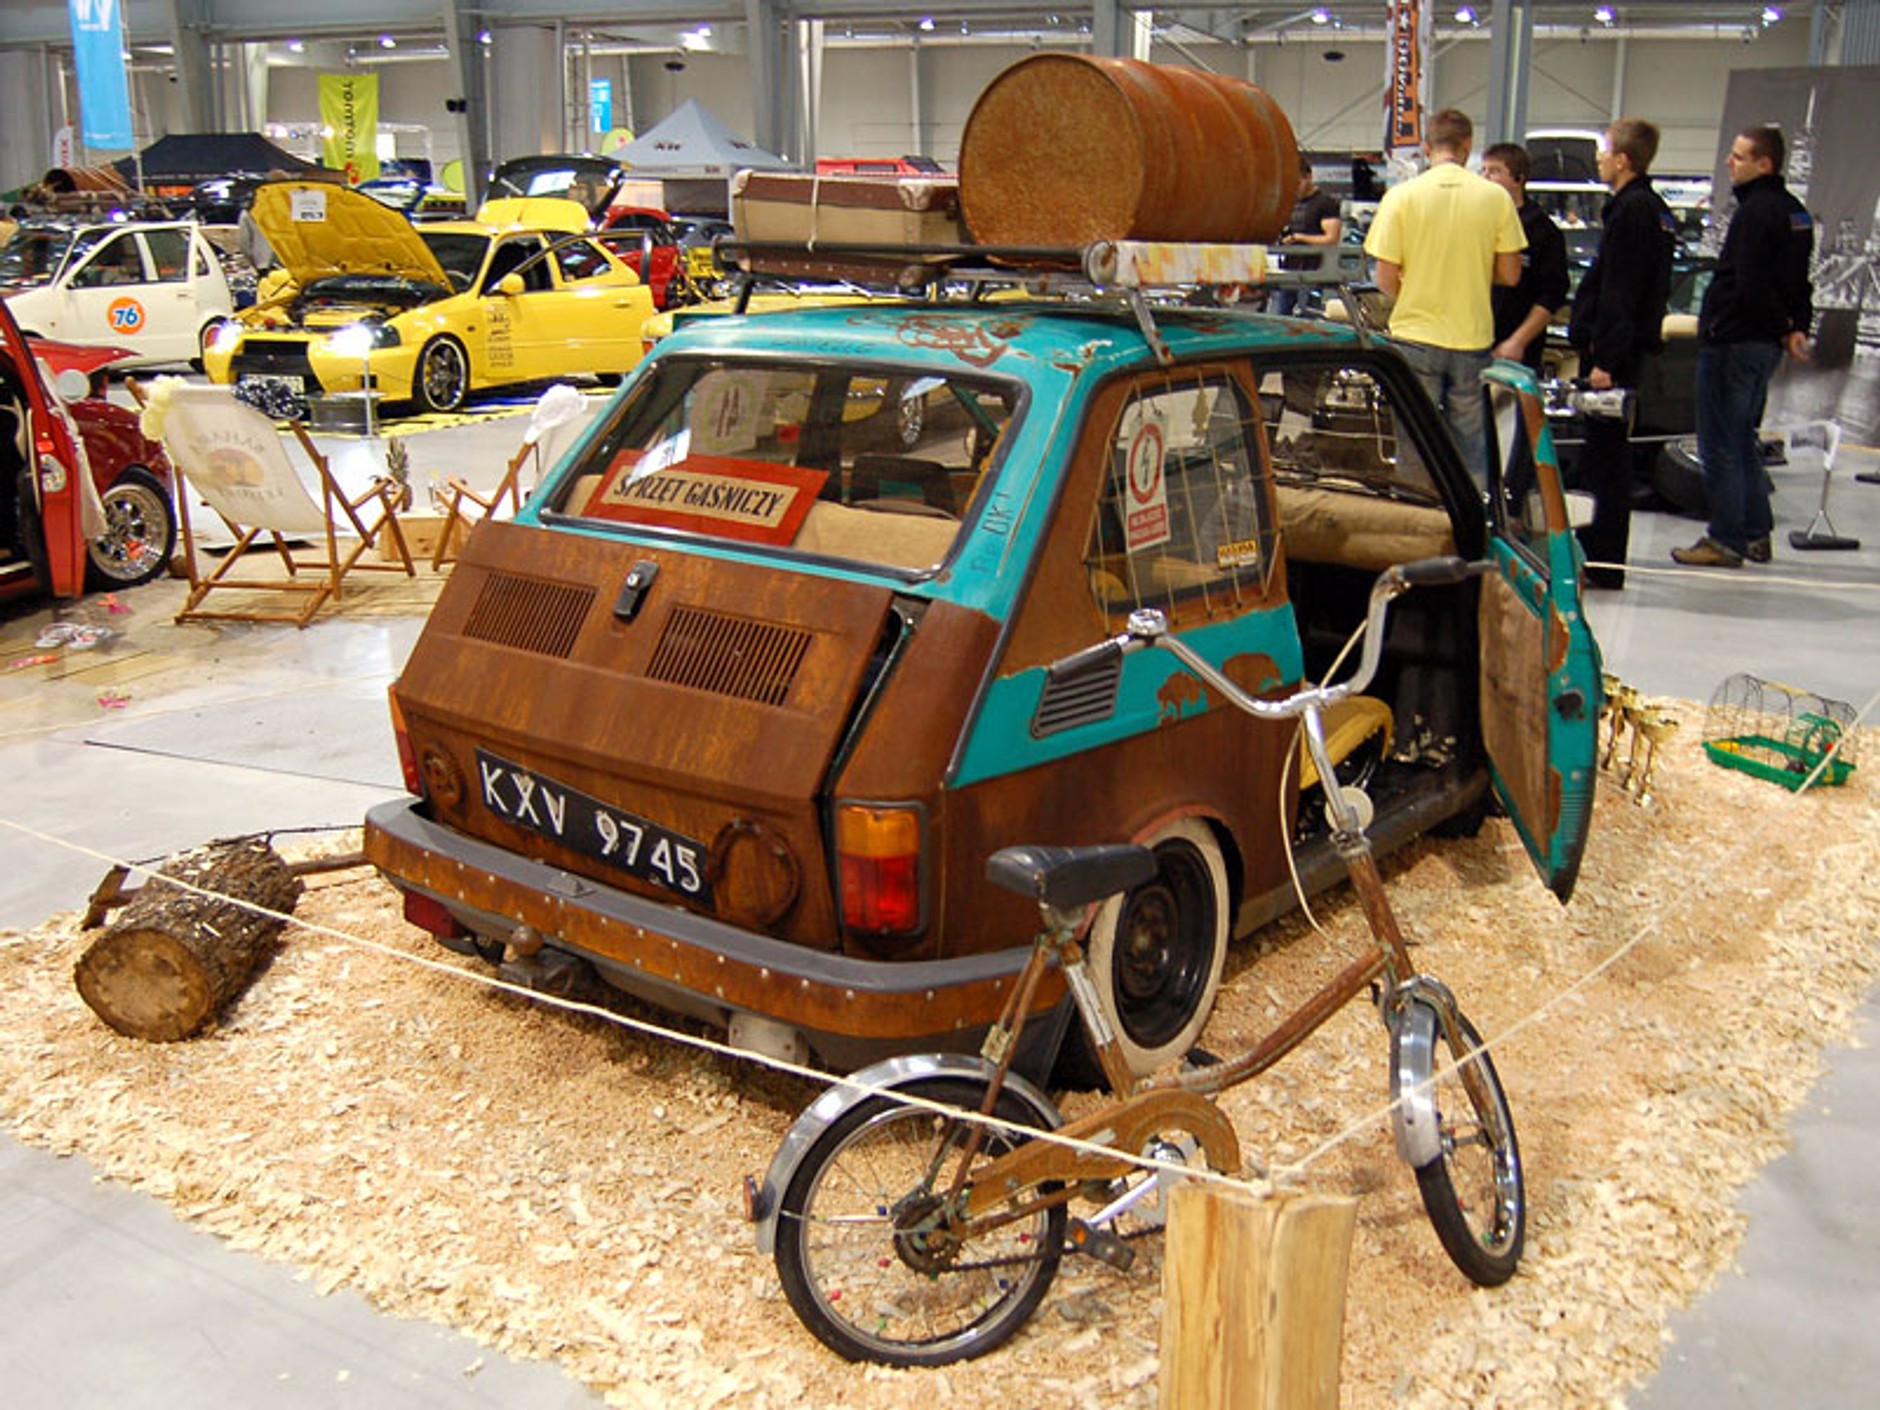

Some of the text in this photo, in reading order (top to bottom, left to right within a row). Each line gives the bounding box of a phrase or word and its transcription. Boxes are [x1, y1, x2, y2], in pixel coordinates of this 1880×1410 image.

[114, 306, 139, 326] 76
[481, 760, 701, 893] KXV 9745
